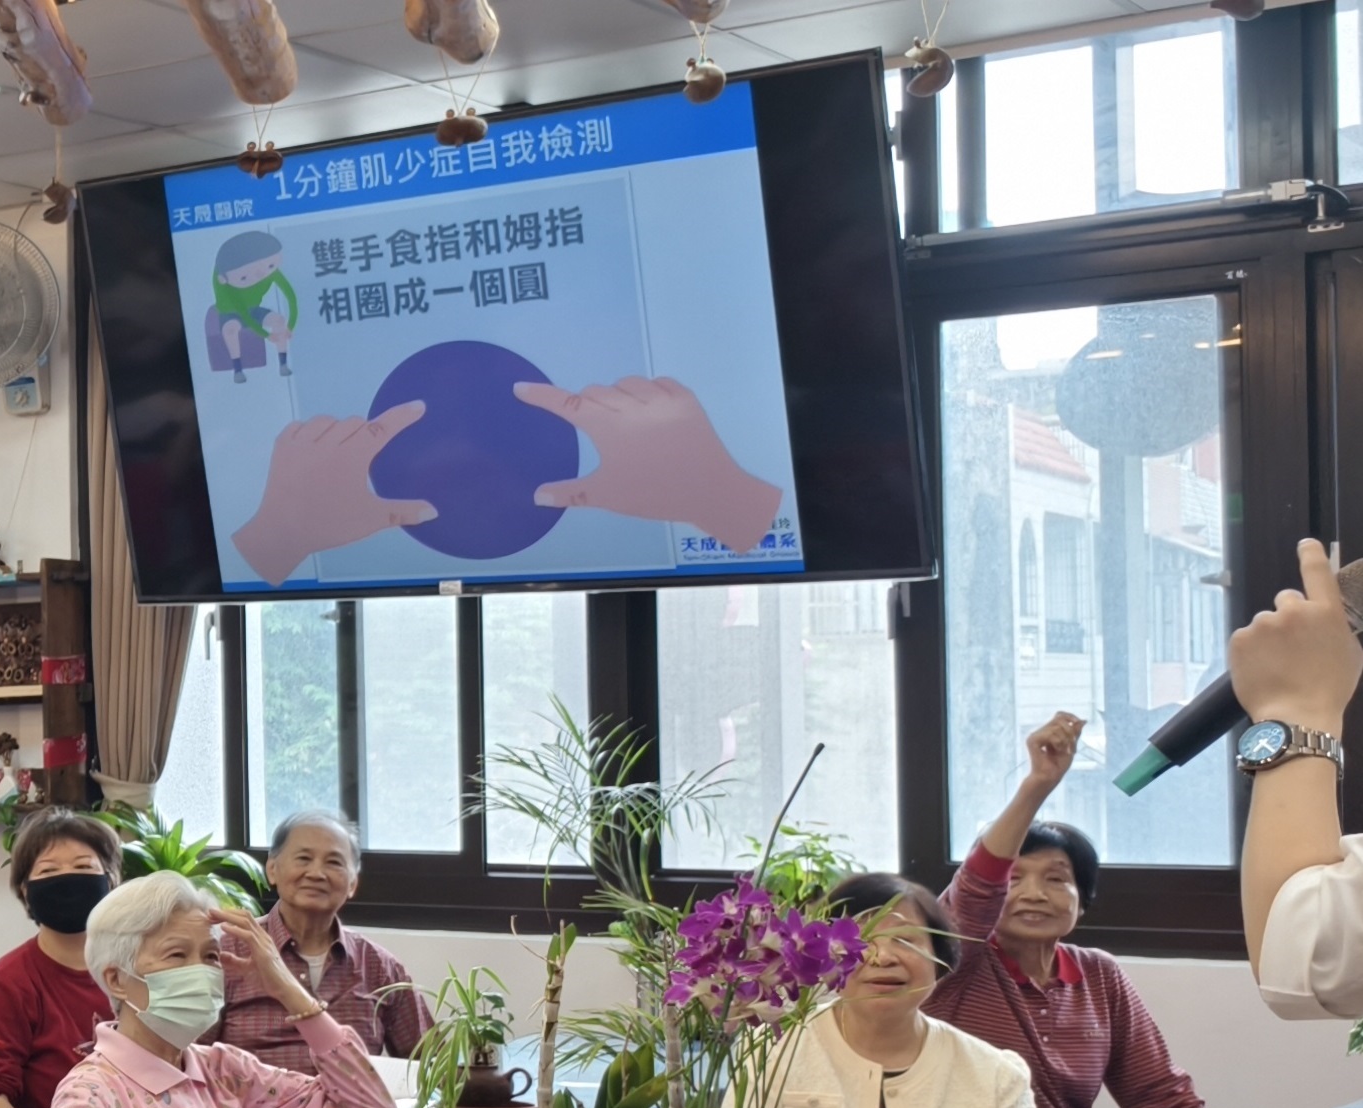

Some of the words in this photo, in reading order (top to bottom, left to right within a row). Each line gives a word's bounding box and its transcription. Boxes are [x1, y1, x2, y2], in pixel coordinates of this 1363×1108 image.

[273, 115, 614, 201] 1分鐘肌少症自我檢測
[172, 198, 255, 227] 天晟醫院
[310, 205, 585, 278] 雙手食指和姆指
[318, 261, 550, 325] 相圈成一個圓
